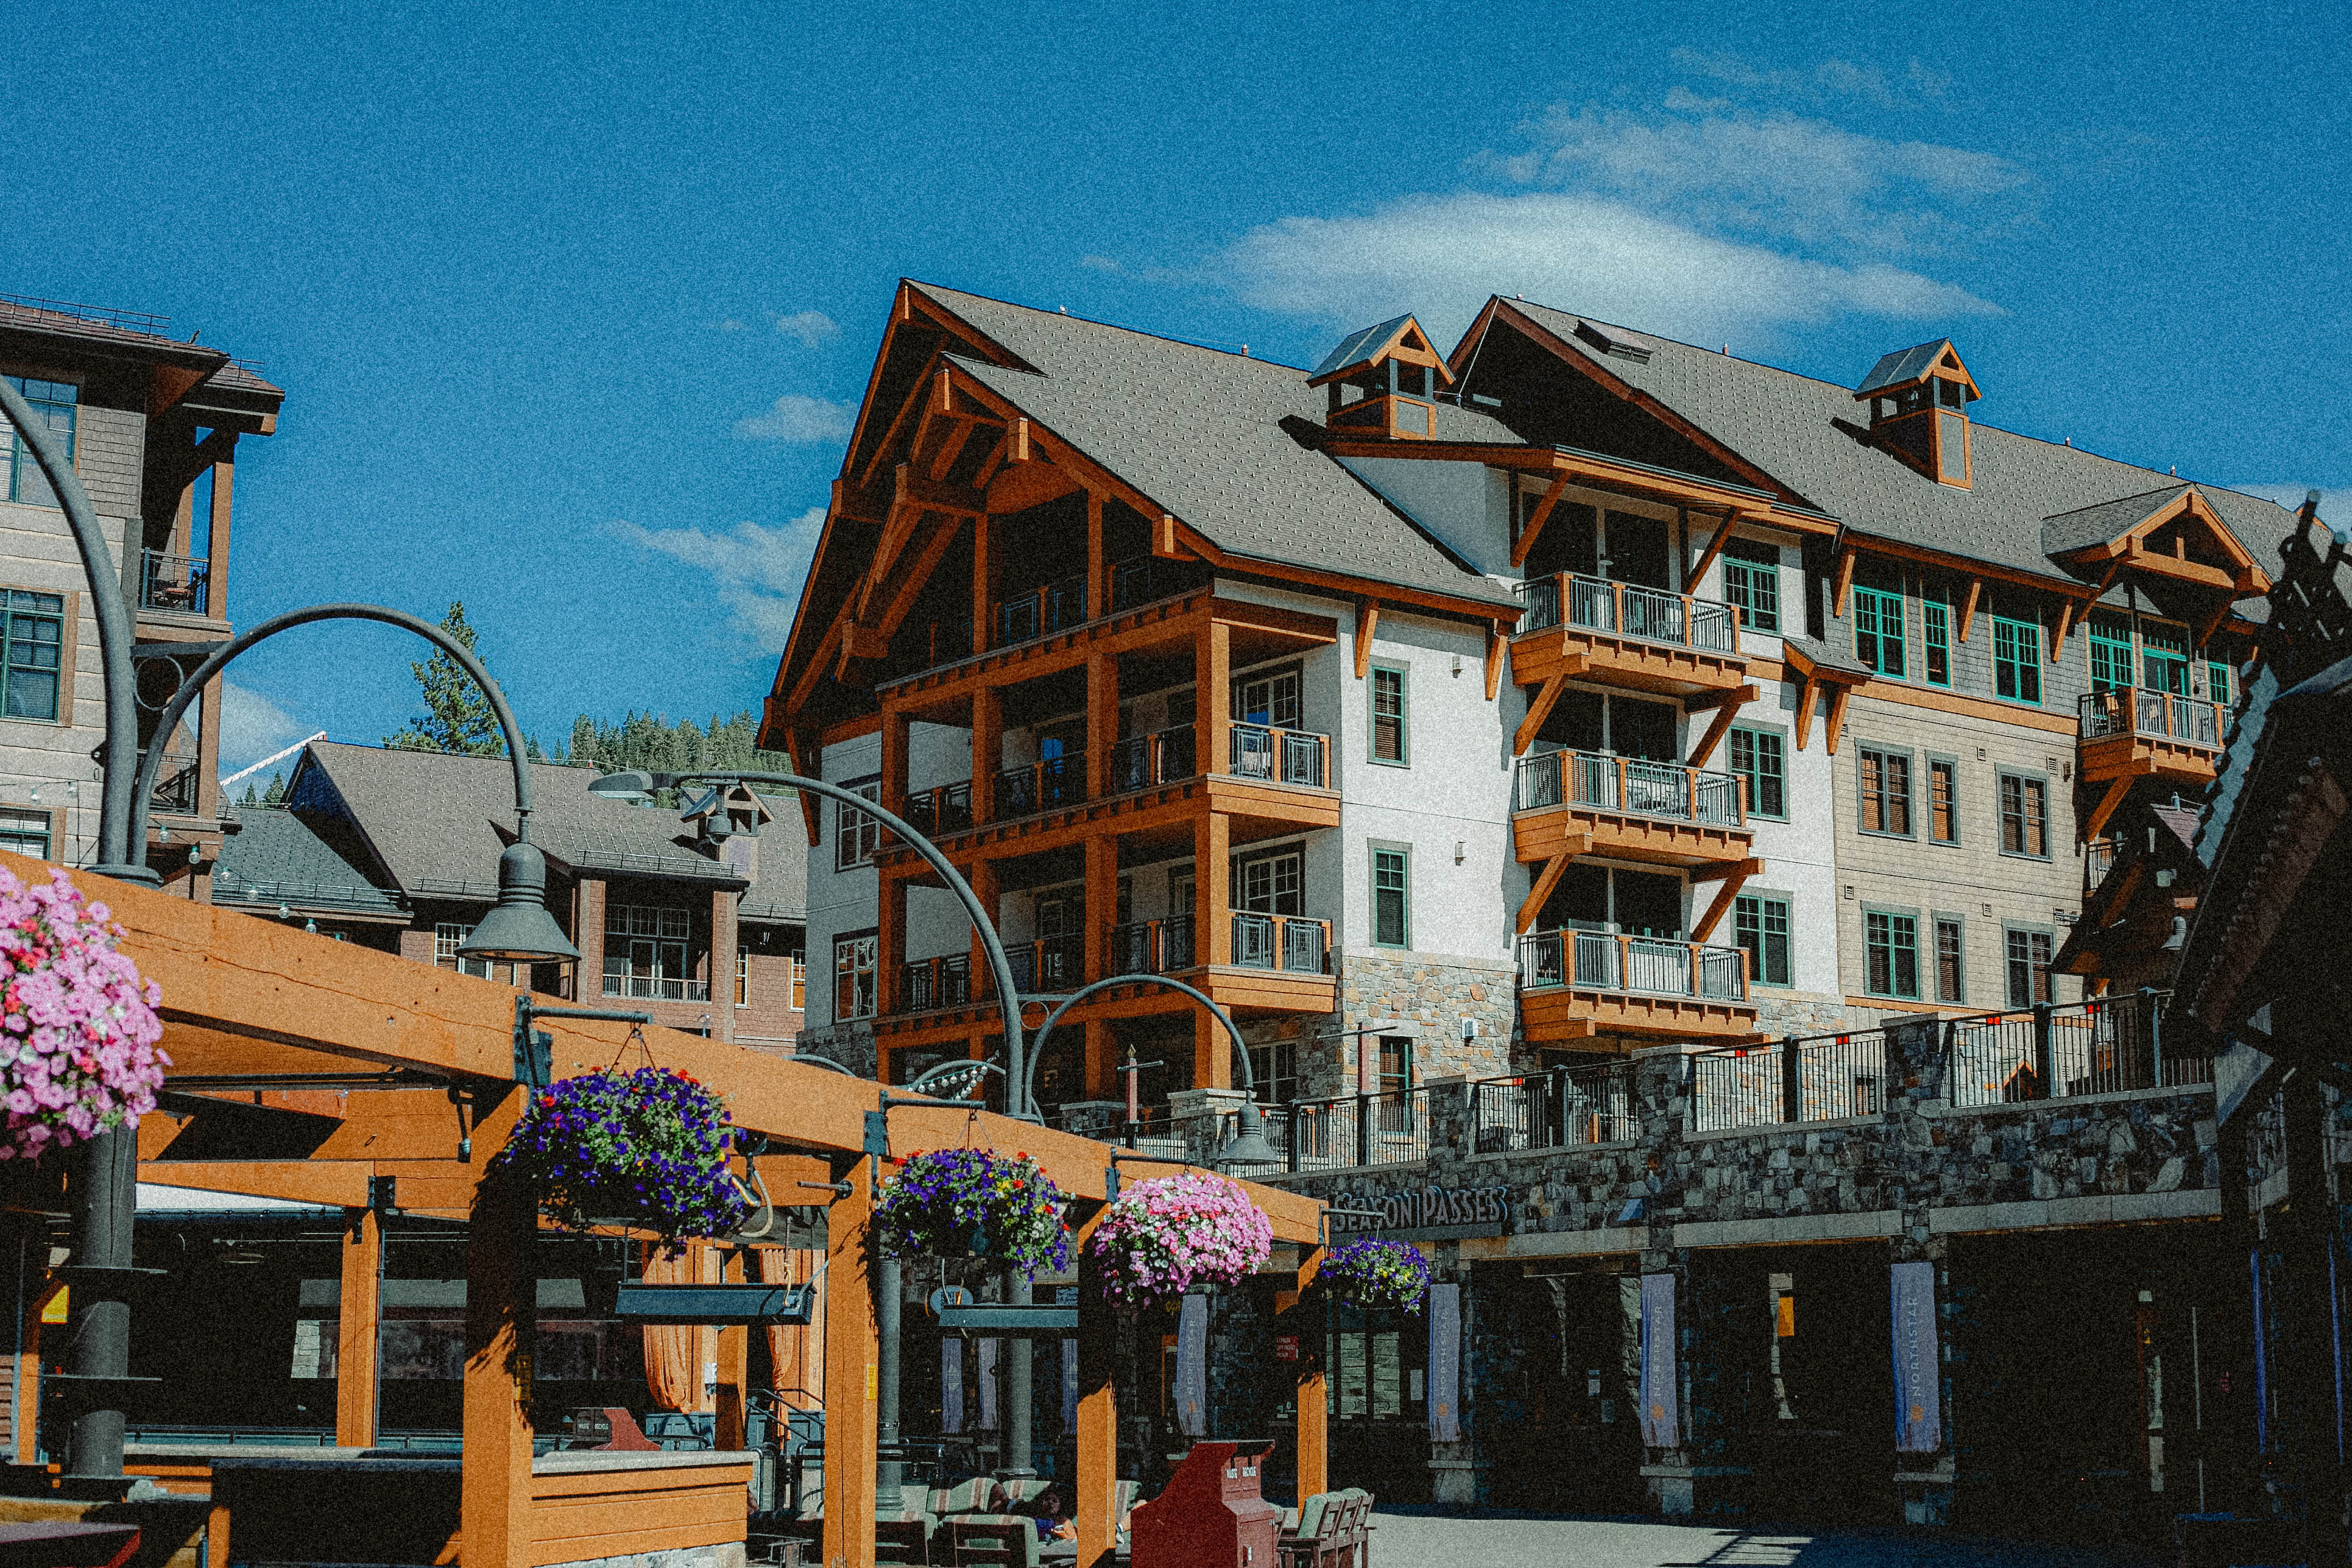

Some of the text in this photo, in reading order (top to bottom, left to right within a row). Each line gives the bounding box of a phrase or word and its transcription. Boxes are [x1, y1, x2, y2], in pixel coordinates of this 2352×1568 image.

[1333, 1187, 1505, 1232] SEASON PASSES
[1439, 1311, 1449, 1396] NORTHSTAR
[1652, 1305, 1663, 1397] NORTHSTAR
[1907, 1296, 1921, 1397] NORTHSTAR
[1226, 1466, 1256, 1479] WASTE RECYCLE
